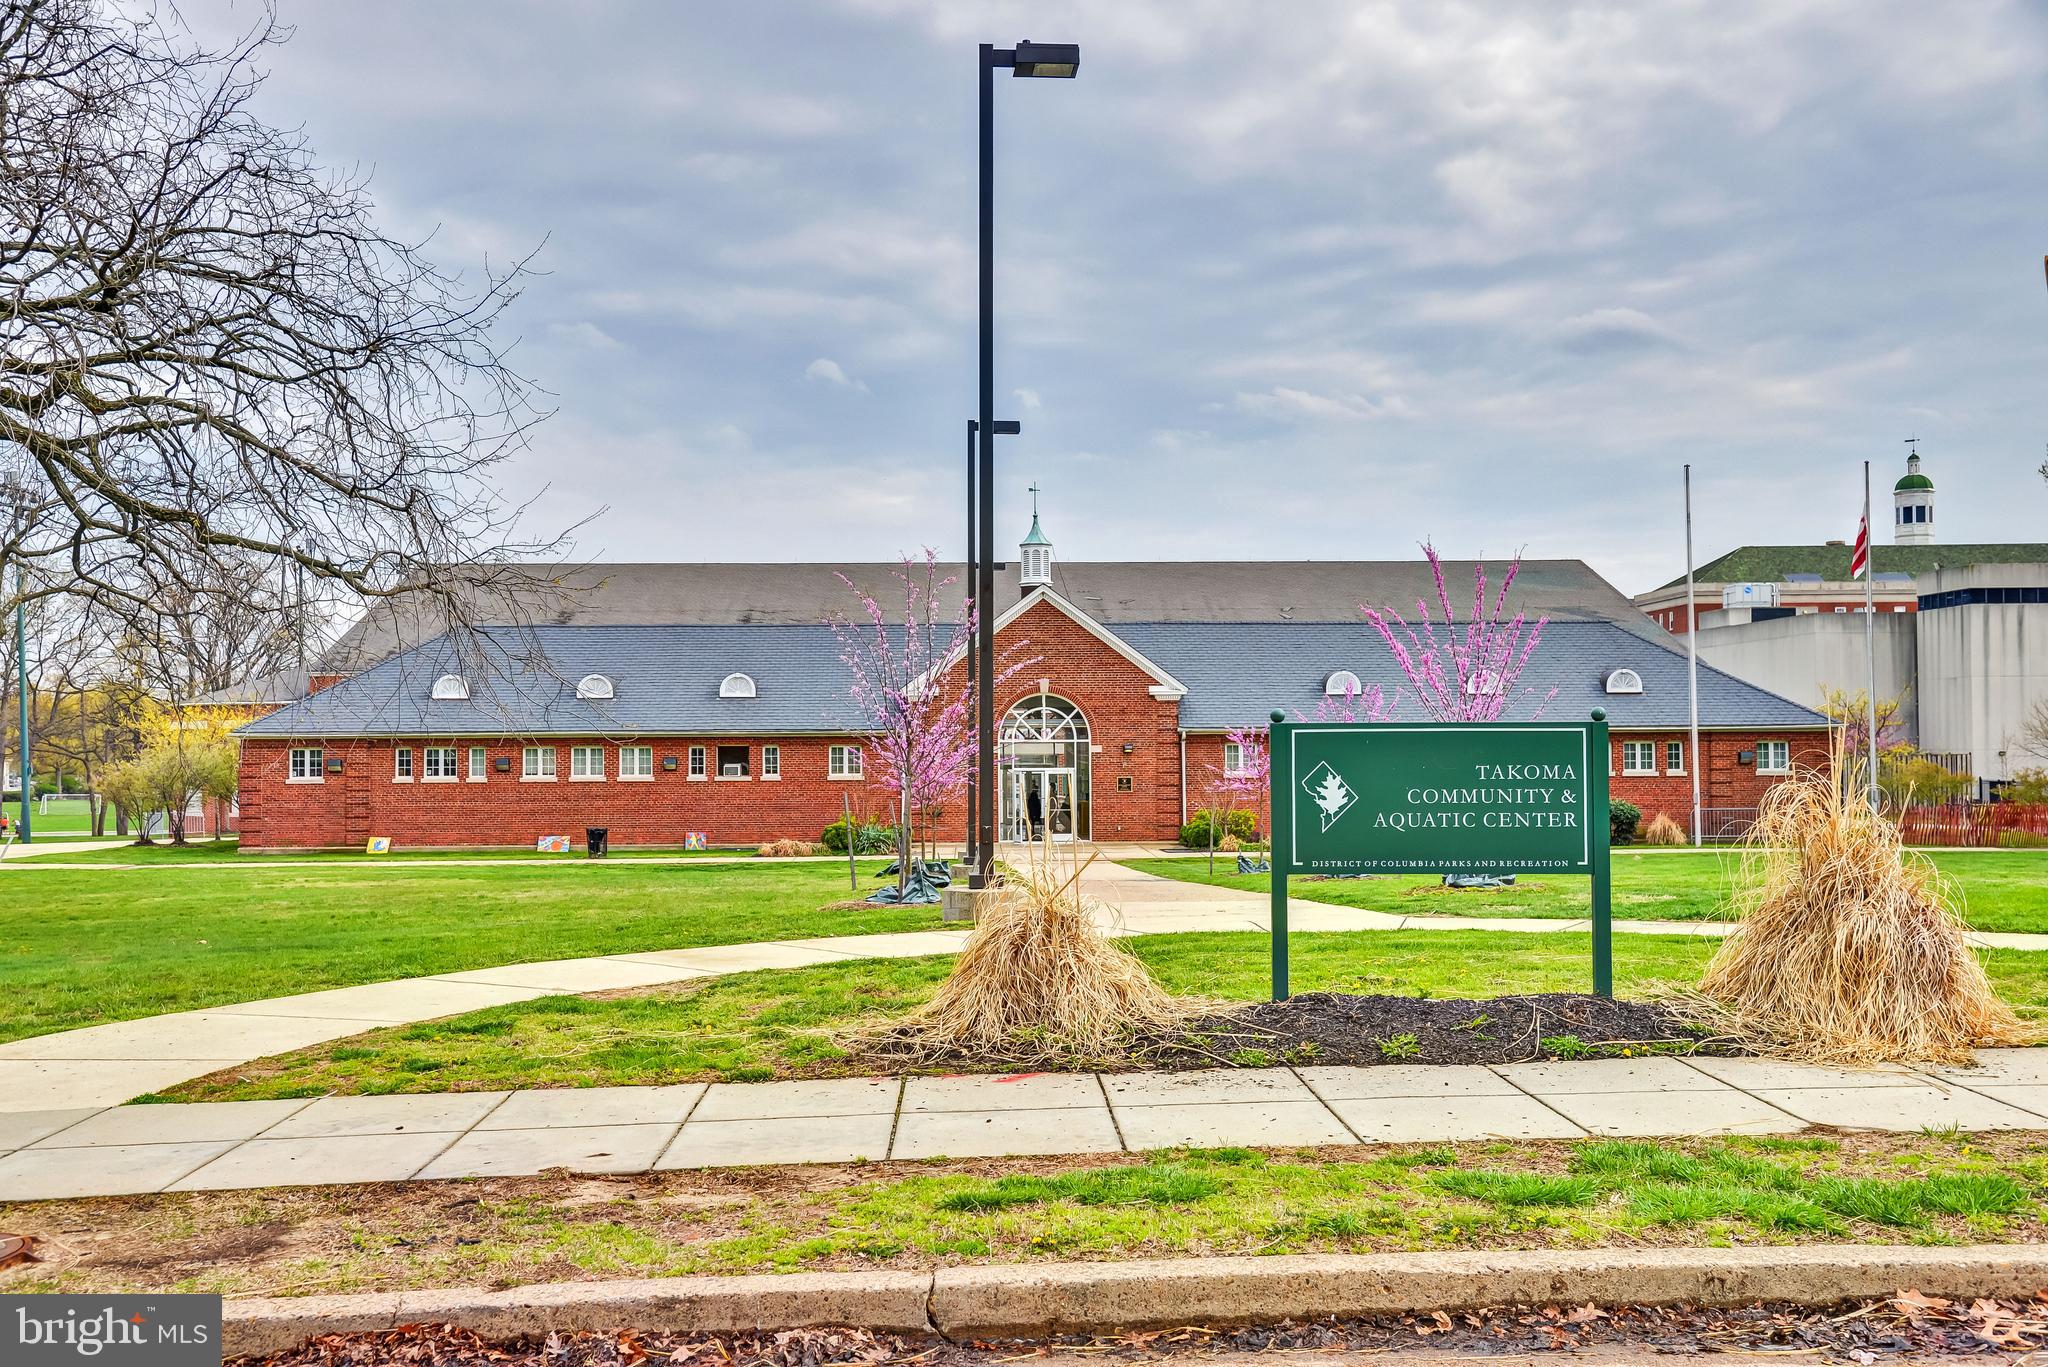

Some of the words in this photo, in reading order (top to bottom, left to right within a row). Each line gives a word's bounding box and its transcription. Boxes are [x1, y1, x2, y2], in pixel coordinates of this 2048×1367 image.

[1475, 764, 1577, 780] TAKOMA
[1407, 788, 1554, 804] COMMUNITY
[1560, 788, 1577, 804] &
[1373, 812, 1476, 832] AQUATIC
[1483, 812, 1578, 828] CENTER
[1311, 860, 1361, 868] DISTRICT
[1364, 860, 1378, 868] OF
[1380, 860, 1436, 868] COLUMBIA
[1439, 860, 1472, 868] PARKS
[1474, 860, 1497, 868] AND
[1499, 860, 1569, 868] RECREATION
